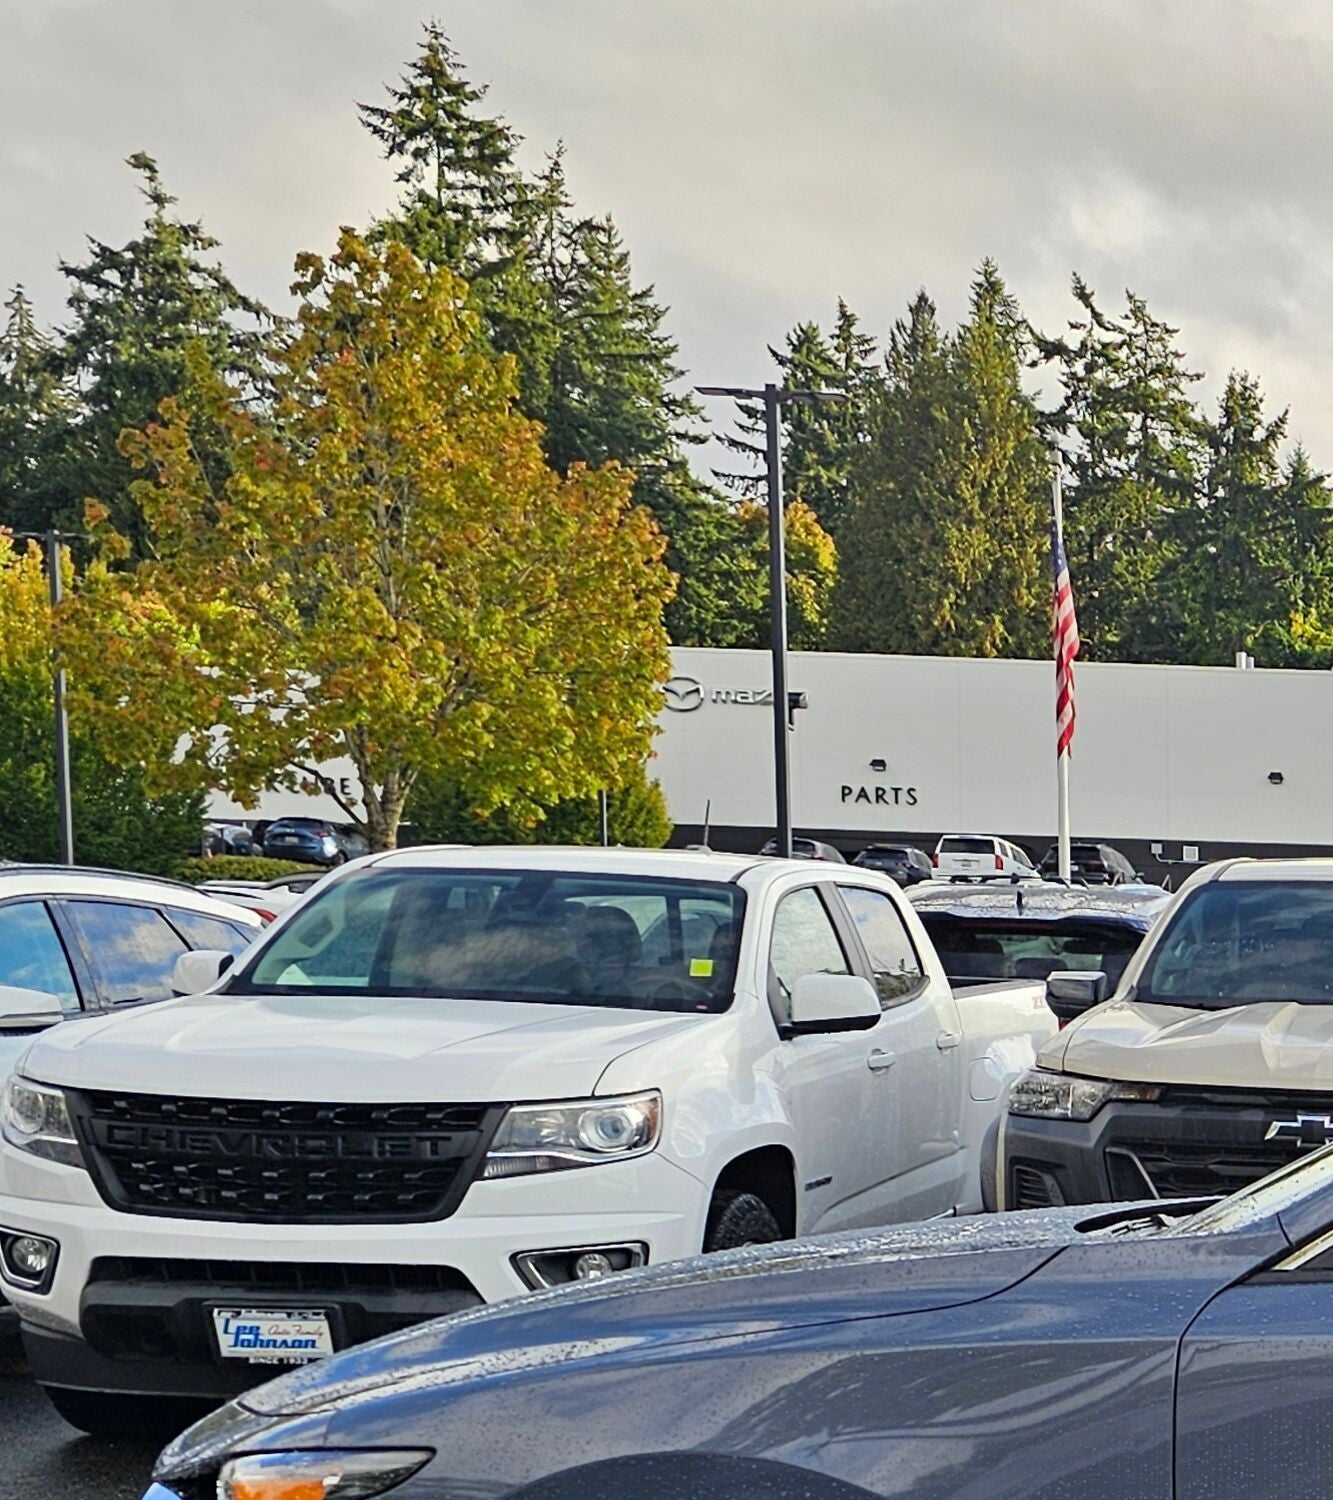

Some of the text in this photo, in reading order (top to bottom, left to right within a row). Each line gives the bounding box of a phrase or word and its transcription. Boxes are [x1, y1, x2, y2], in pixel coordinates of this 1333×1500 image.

[711, 688, 775, 705] maz
[841, 785, 918, 806] PARTS
[106, 1123, 453, 1159] CHEVROLET
[223, 1317, 262, 1335] Lee
[228, 1326, 320, 1349] Johnson
